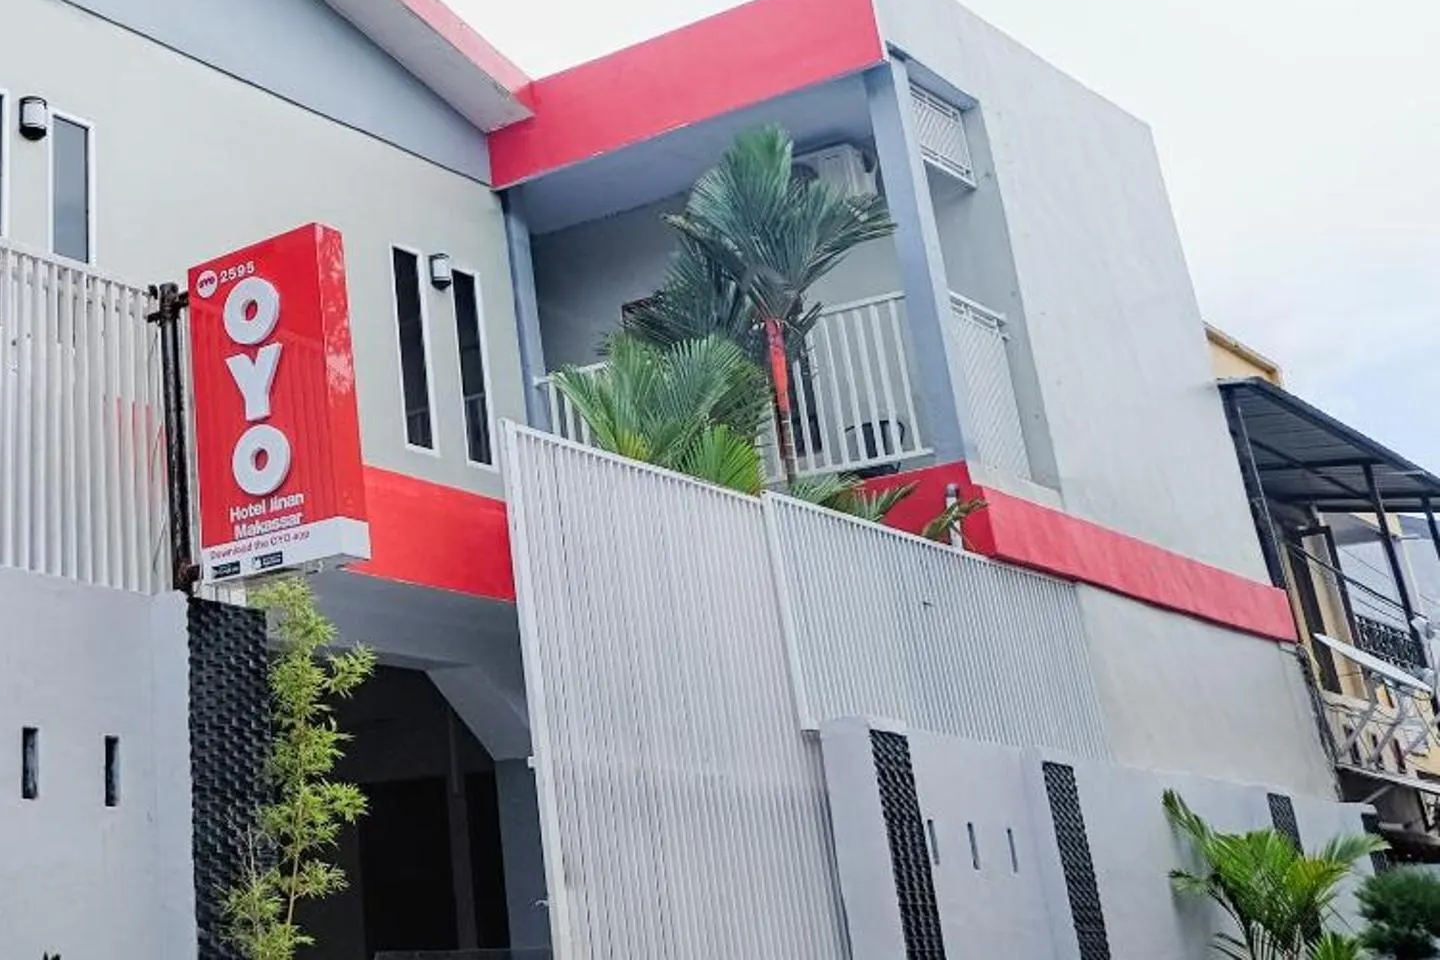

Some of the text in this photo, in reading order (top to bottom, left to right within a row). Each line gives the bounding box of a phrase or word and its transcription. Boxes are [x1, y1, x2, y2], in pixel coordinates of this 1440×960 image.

[220, 261, 255, 284] 2595
[223, 276, 291, 496] OYO
[230, 493, 304, 523] Hotel Jinan
[234, 512, 303, 540] Makassar
